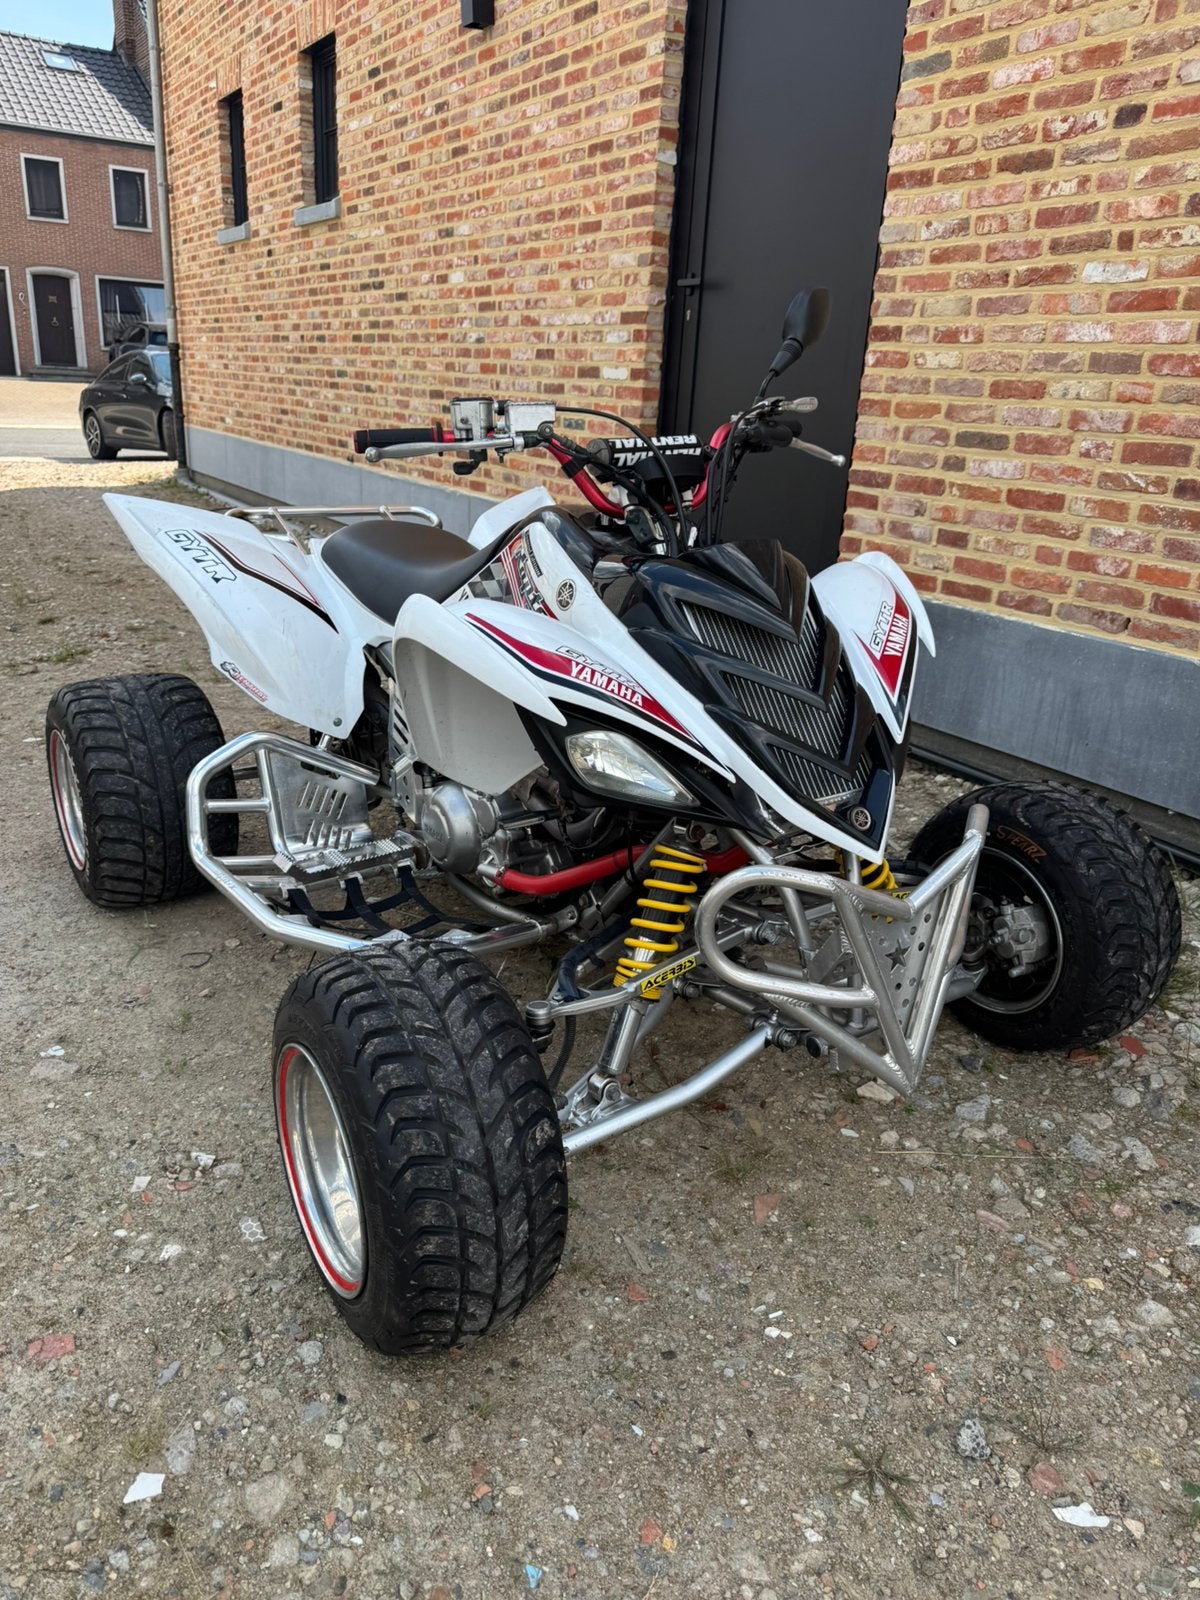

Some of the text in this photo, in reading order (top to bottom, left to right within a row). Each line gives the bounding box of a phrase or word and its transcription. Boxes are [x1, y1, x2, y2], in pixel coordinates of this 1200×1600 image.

[609, 434, 698, 449] RENTHAL
[164, 528, 238, 584] GYTR
[869, 600, 894, 653] GYTR
[882, 612, 910, 657] YAMAHA
[570, 660, 643, 707] YAMAHA
[643, 958, 696, 991] ACERBIS
